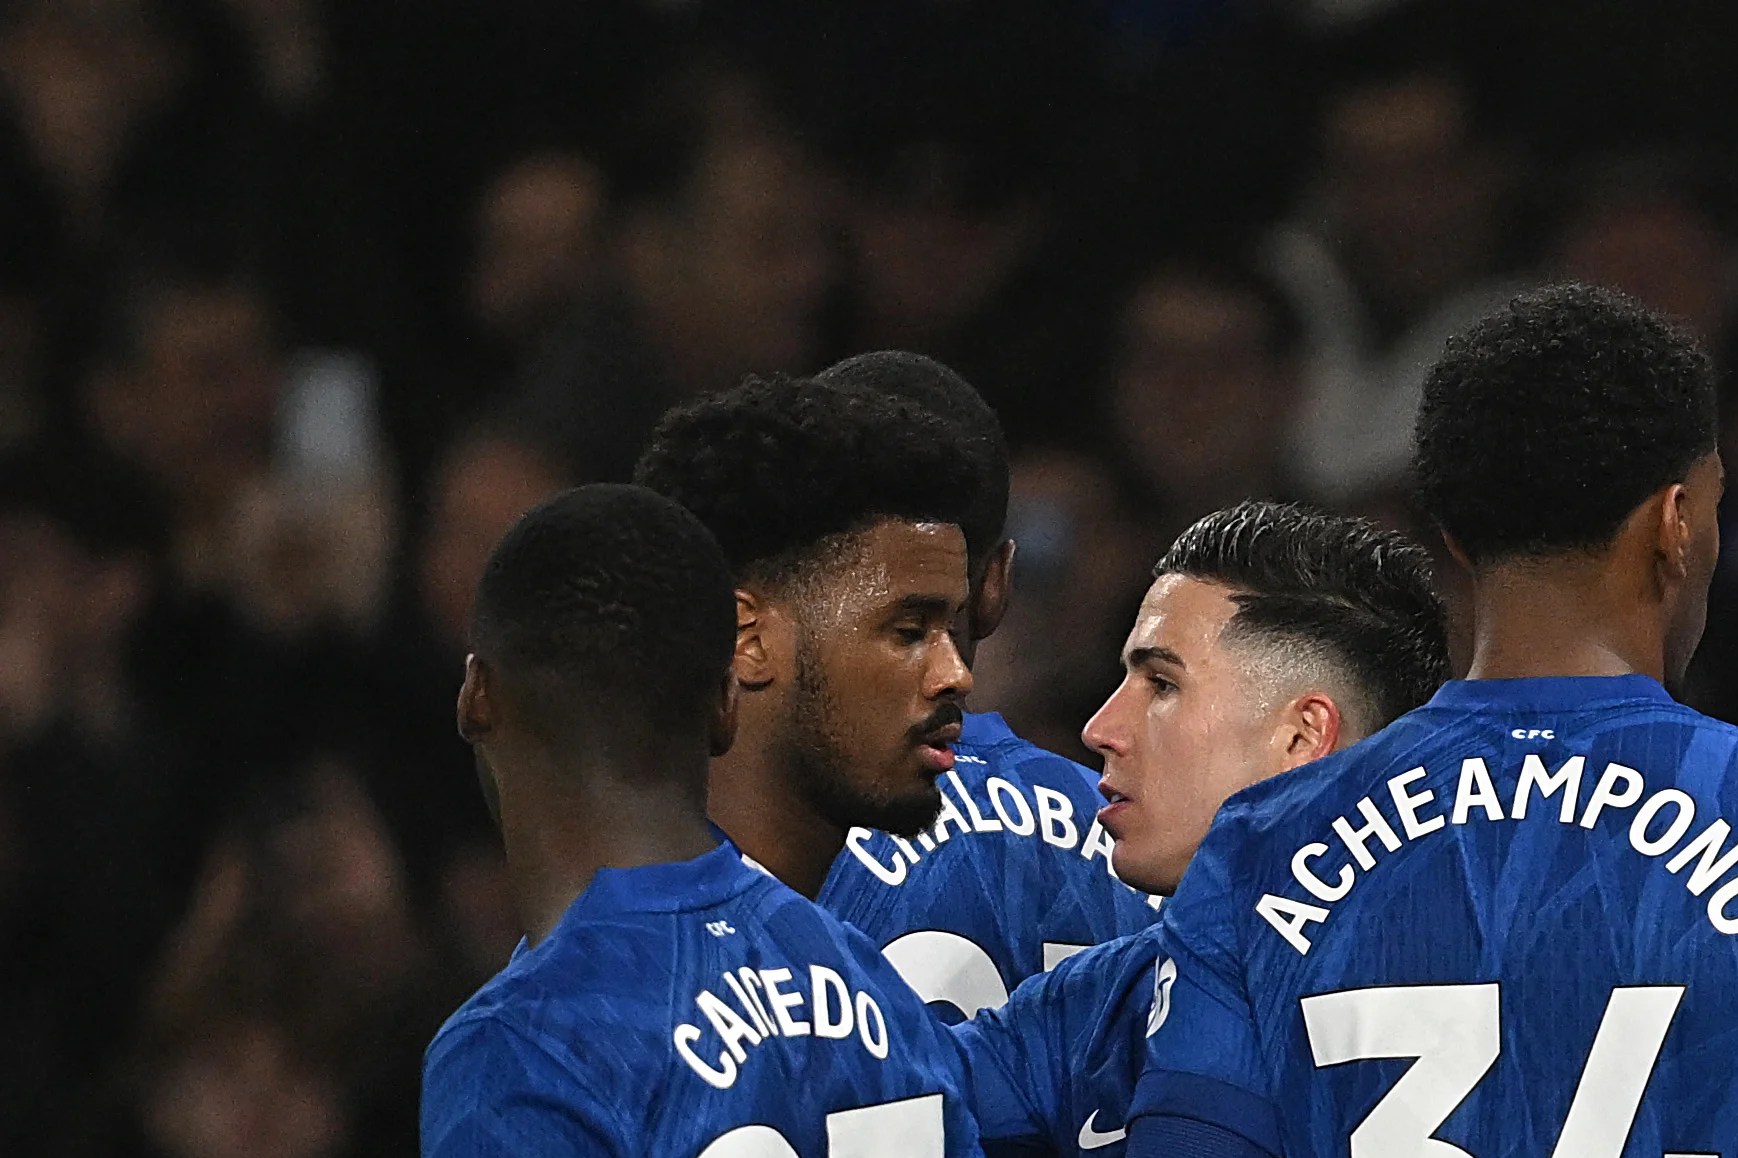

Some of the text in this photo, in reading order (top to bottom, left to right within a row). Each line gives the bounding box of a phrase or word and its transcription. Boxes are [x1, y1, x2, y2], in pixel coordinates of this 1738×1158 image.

[1511, 728, 1555, 740] CFC
[846, 770, 1164, 912] CALOBA
[673, 966, 889, 1089] CAICEDO
